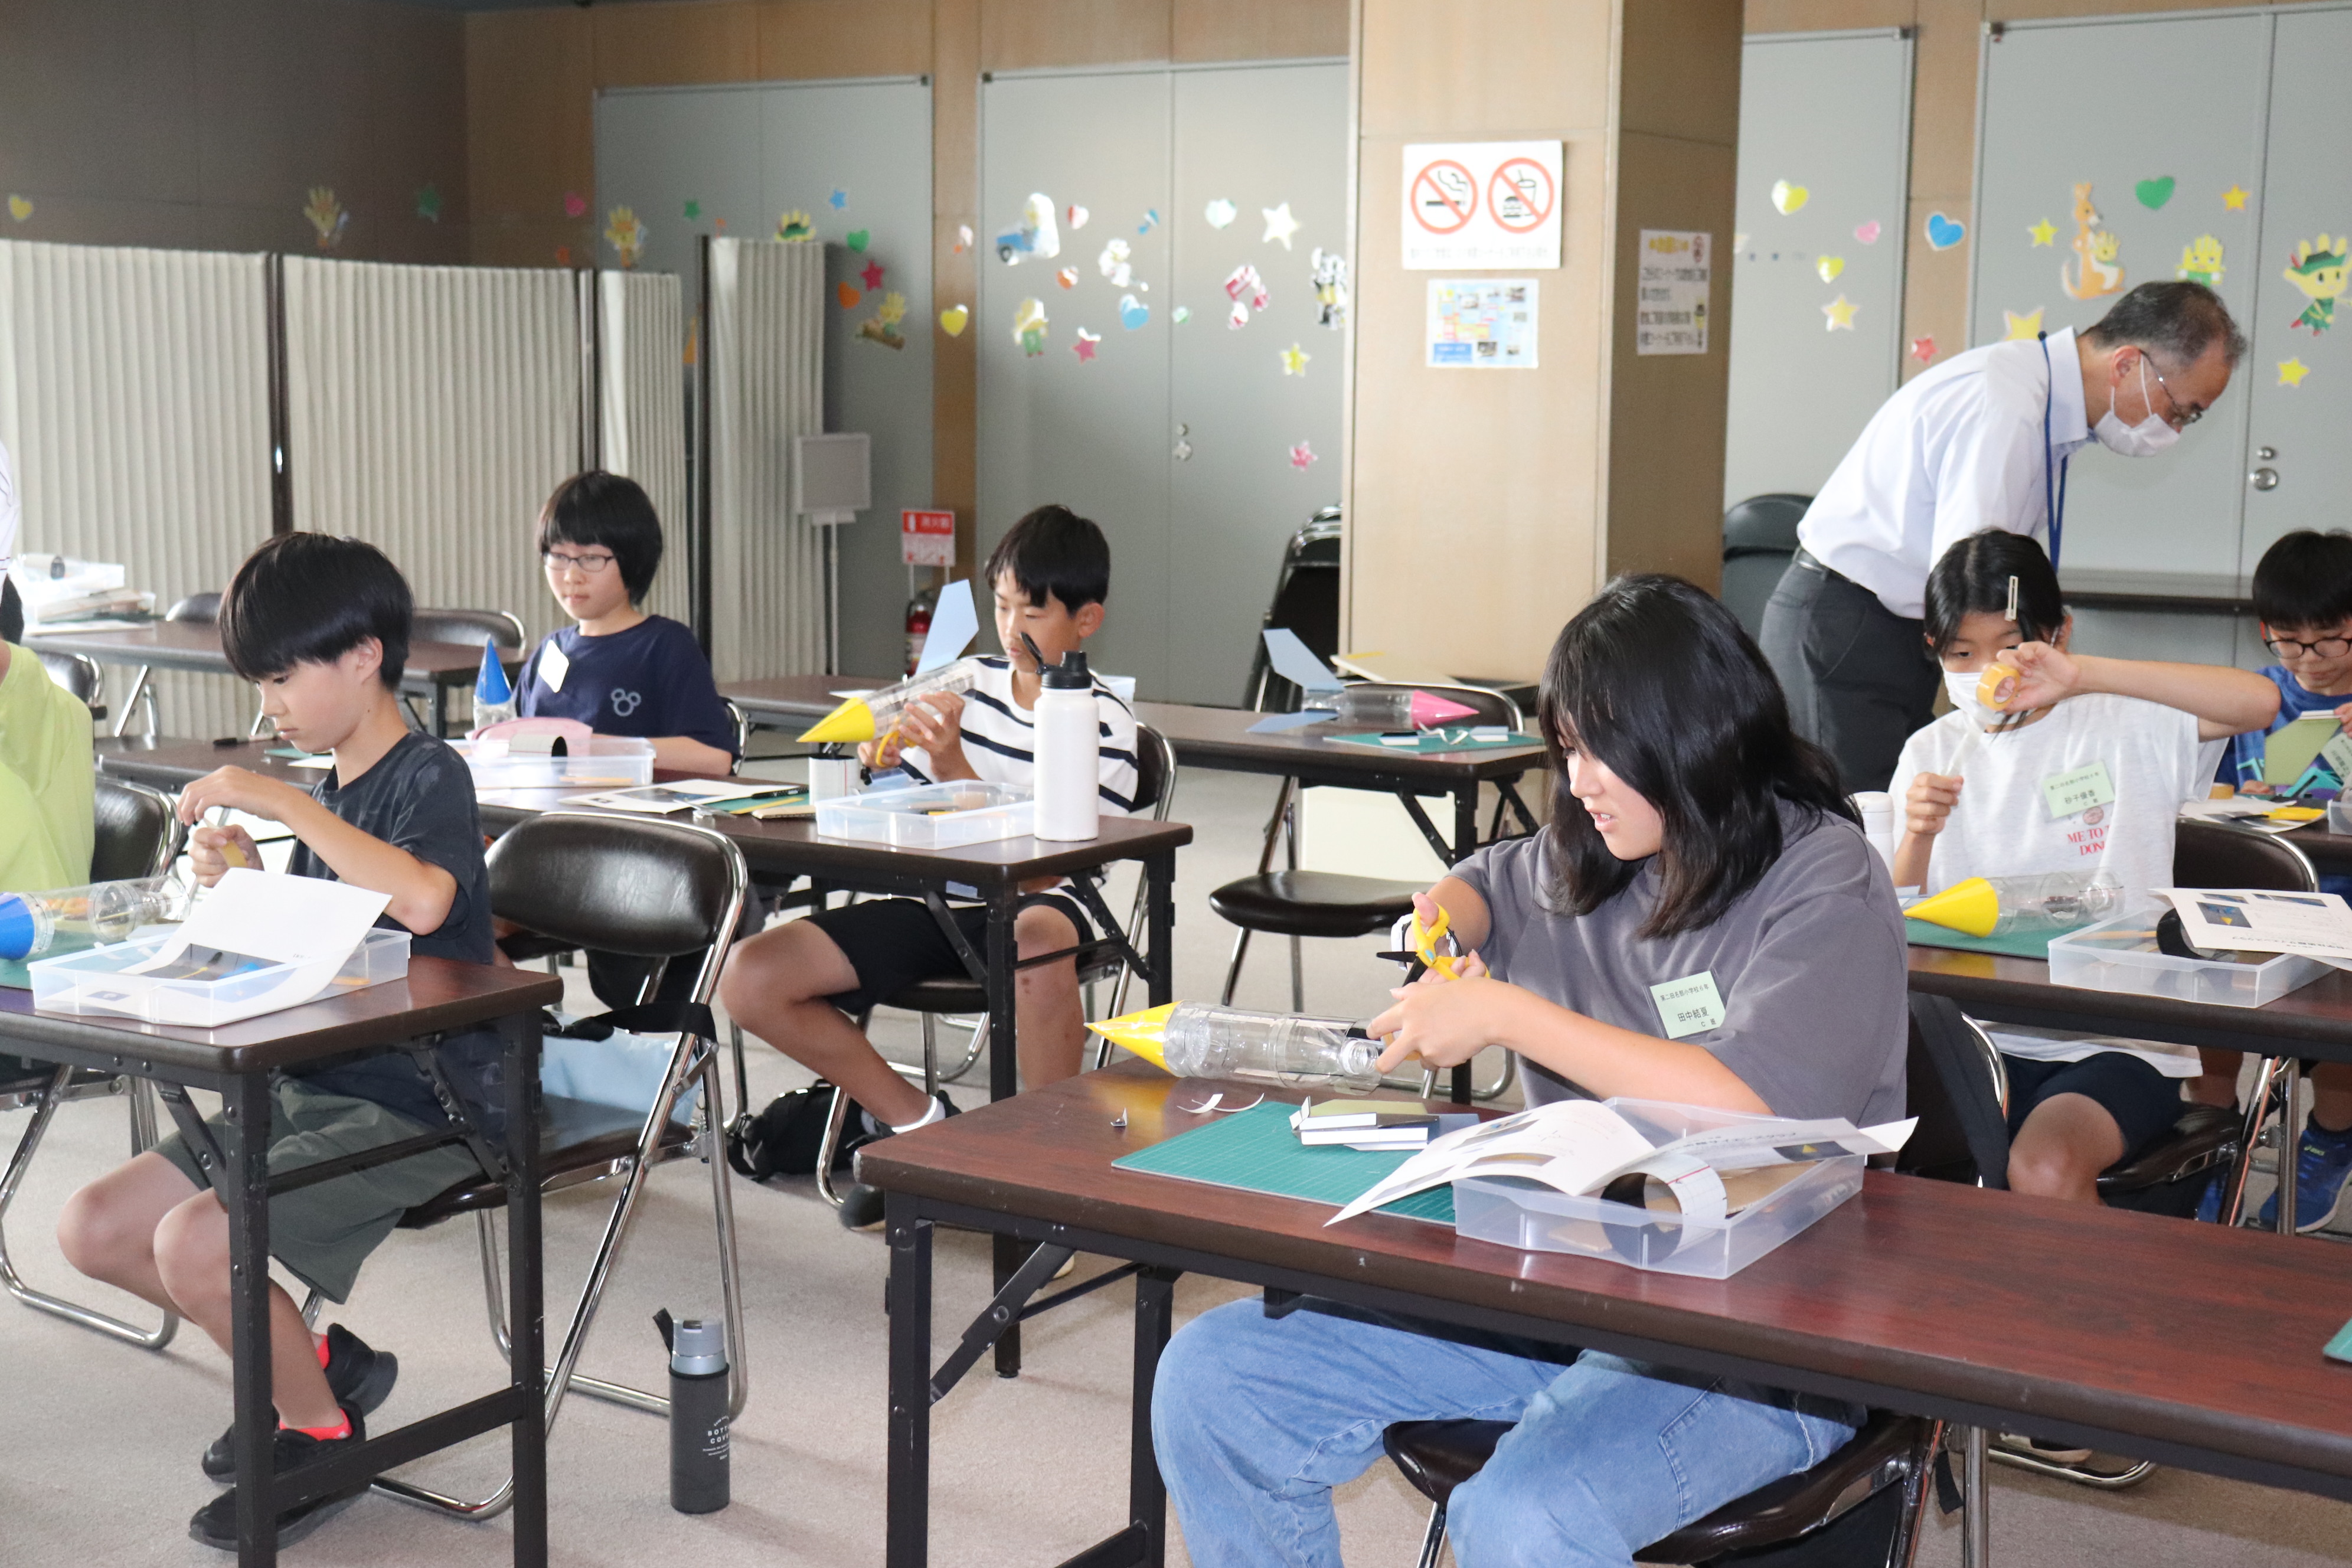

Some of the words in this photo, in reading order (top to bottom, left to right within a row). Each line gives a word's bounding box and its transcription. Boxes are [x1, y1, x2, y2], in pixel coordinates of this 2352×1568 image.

[2067, 831, 2086, 844] ME
[2087, 827, 2104, 839] TO
[1677, 1007, 1709, 1022] 田中結夏
